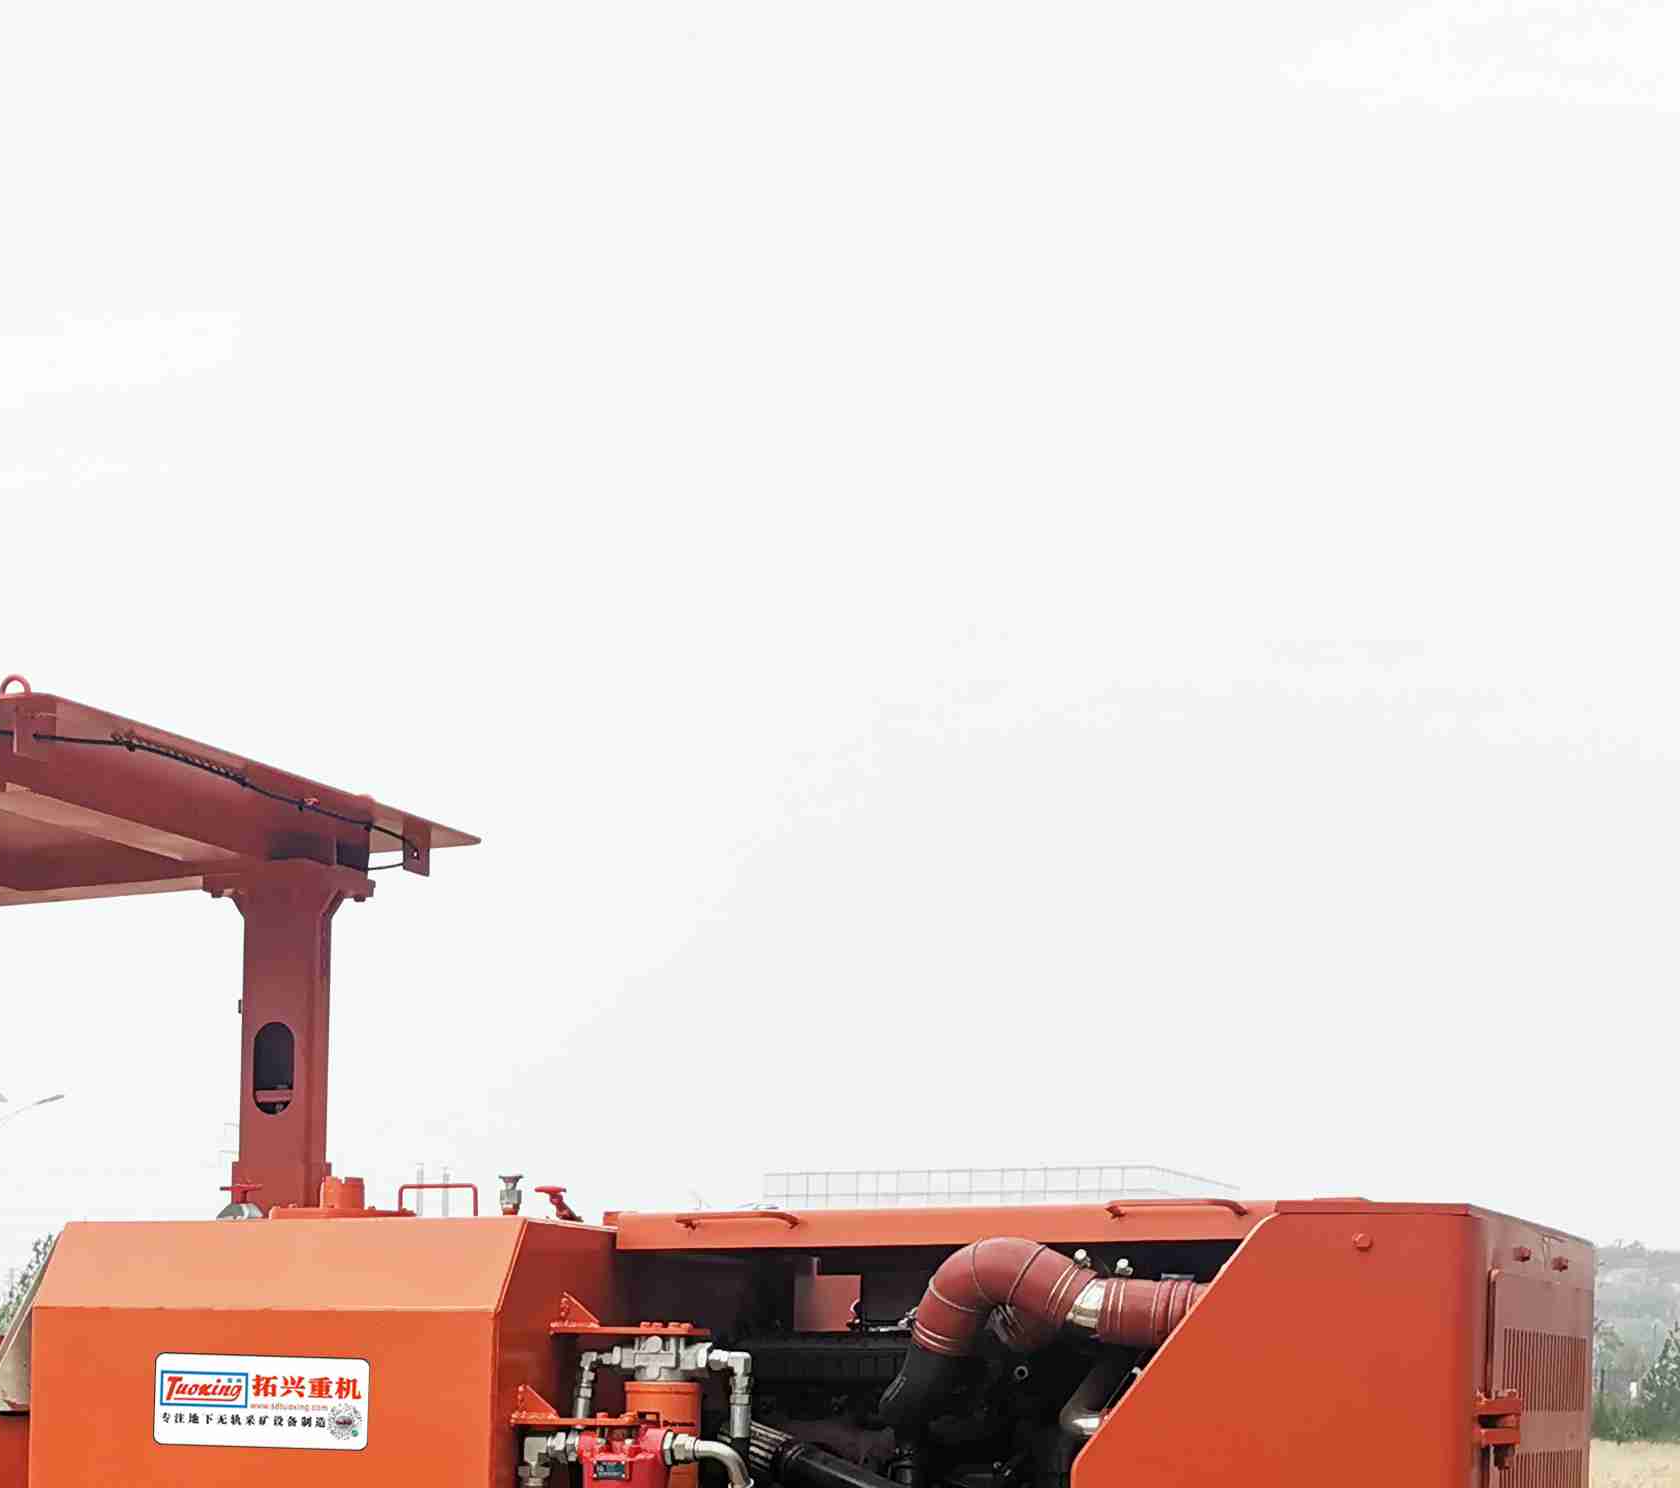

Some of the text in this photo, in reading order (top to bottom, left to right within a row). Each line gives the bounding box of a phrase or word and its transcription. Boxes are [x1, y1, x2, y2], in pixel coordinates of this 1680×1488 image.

[166, 1376, 242, 1401] Tuoxing
[252, 1374, 362, 1399] 拓兴重机
[161, 1412, 326, 1428] 专注地下无轨采矿设备制造
